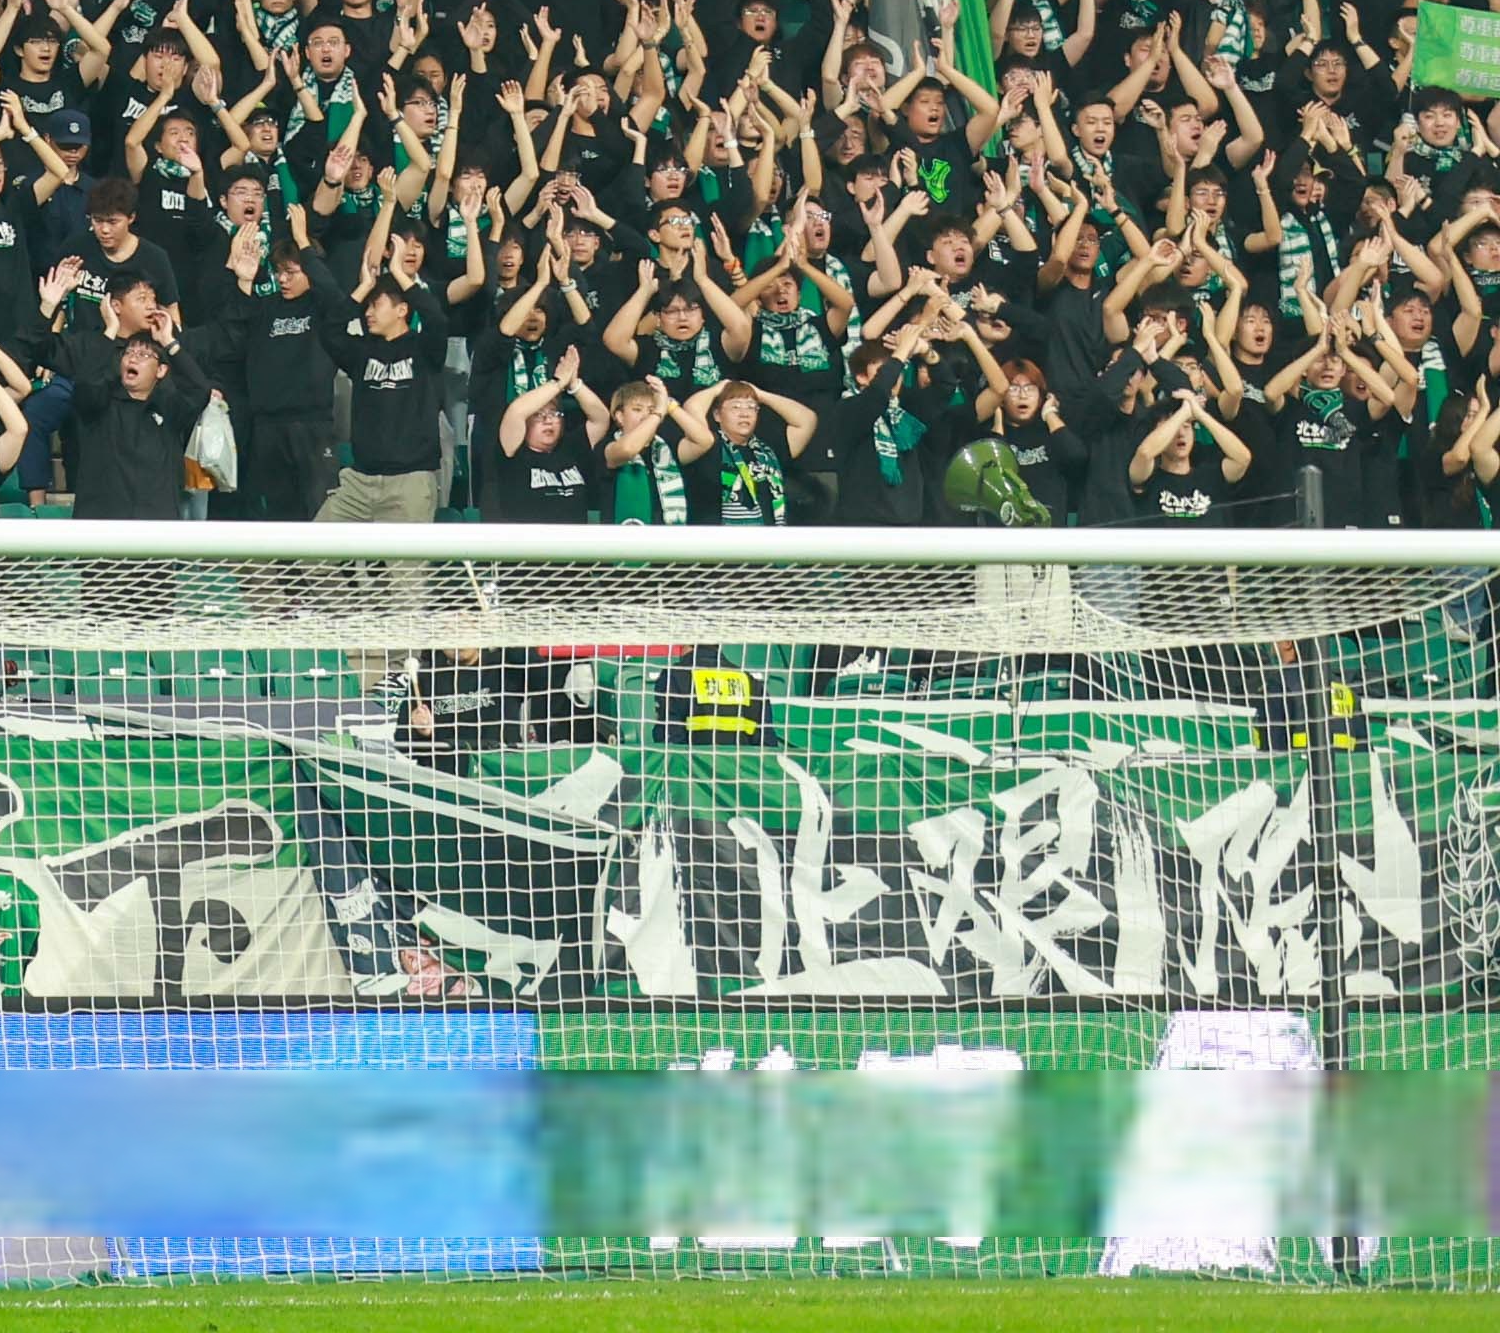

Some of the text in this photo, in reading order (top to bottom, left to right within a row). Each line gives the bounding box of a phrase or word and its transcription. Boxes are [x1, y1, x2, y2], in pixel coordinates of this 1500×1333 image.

[1458, 12, 1500, 39] 尊重
[1457, 42, 1500, 69] 尊重
[1456, 69, 1500, 95] 尊重
